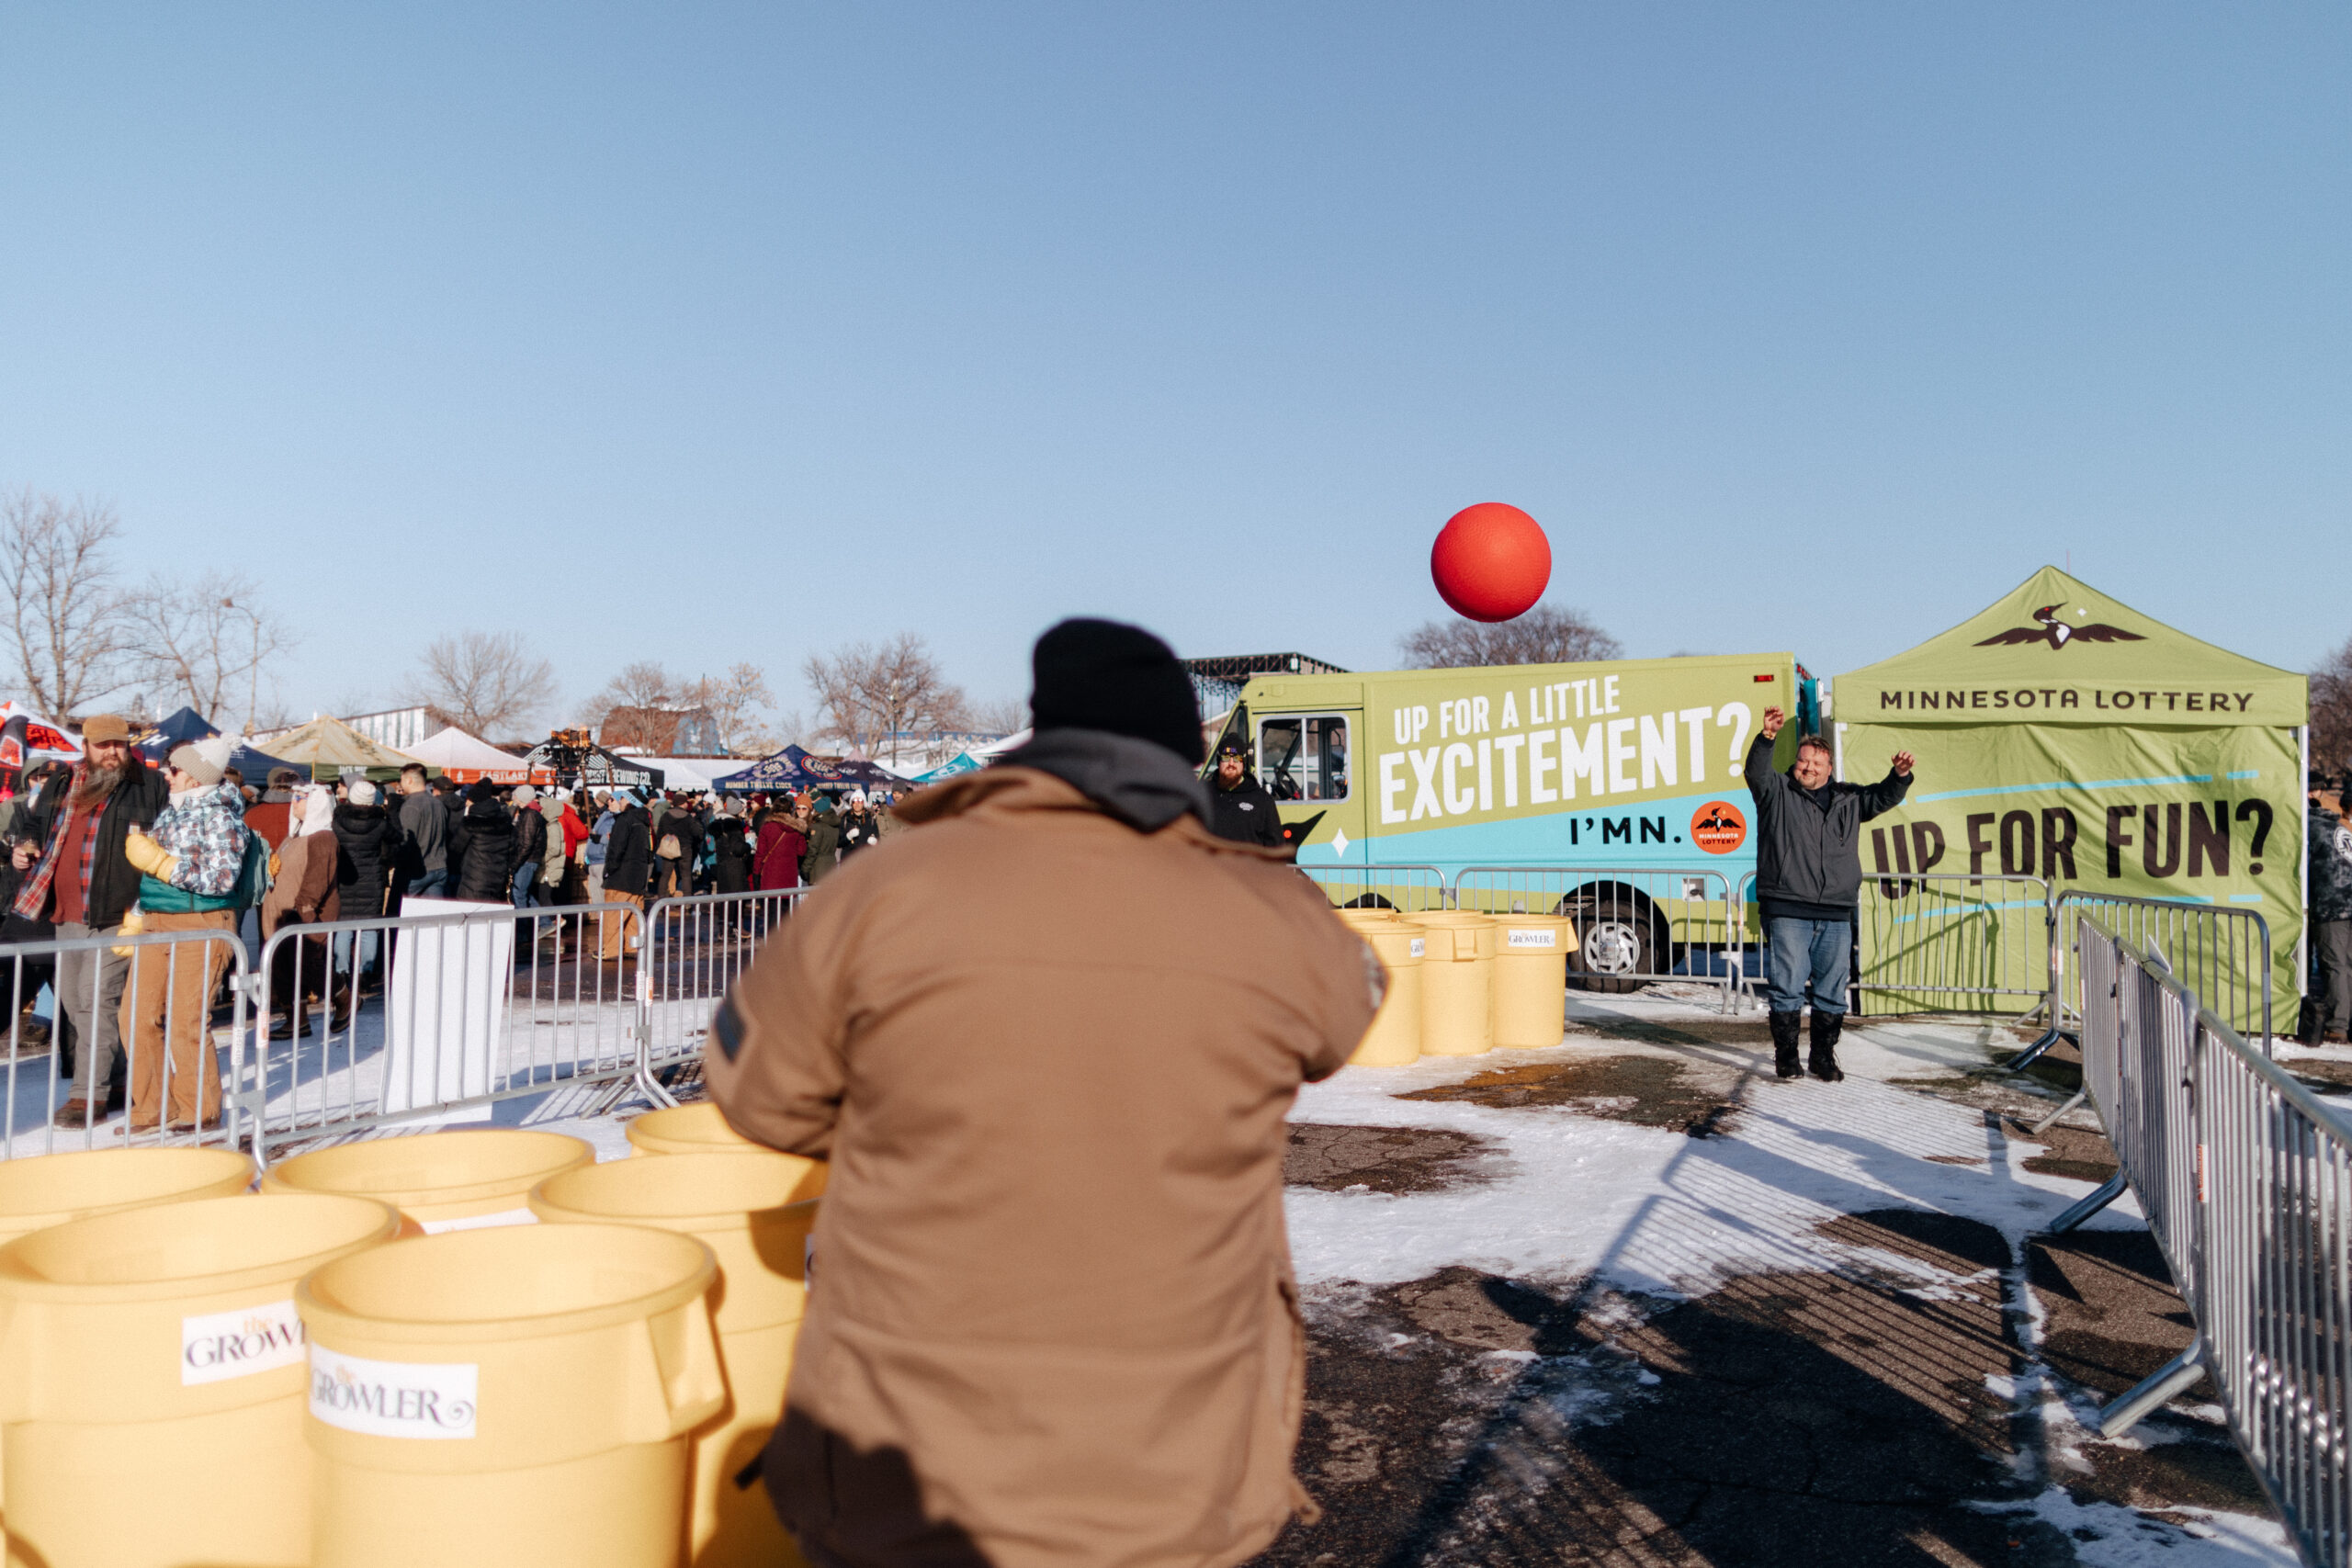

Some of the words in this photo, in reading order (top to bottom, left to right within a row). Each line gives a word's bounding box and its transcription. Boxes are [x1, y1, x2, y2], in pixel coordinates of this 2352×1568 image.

[1395, 705, 1429, 745] UP
[1440, 695, 1490, 739] FOR
[1501, 691, 1520, 729] A
[1530, 675, 1620, 725] LITTLE
[1880, 688, 2079, 710] MINNESOTA
[2095, 690, 2256, 713] LOTTERY
[479, 771, 528, 782] EASTLAK
[1379, 702, 1752, 825] EXCITEMENT?
[1570, 816, 1682, 845] I'MN.
[1871, 820, 1946, 900] UP
[1966, 807, 2078, 886] FOR
[2105, 798, 2274, 879] FUN?
[1509, 935, 1551, 944] GROWLER
[311, 1368, 474, 1429] GROWLER
